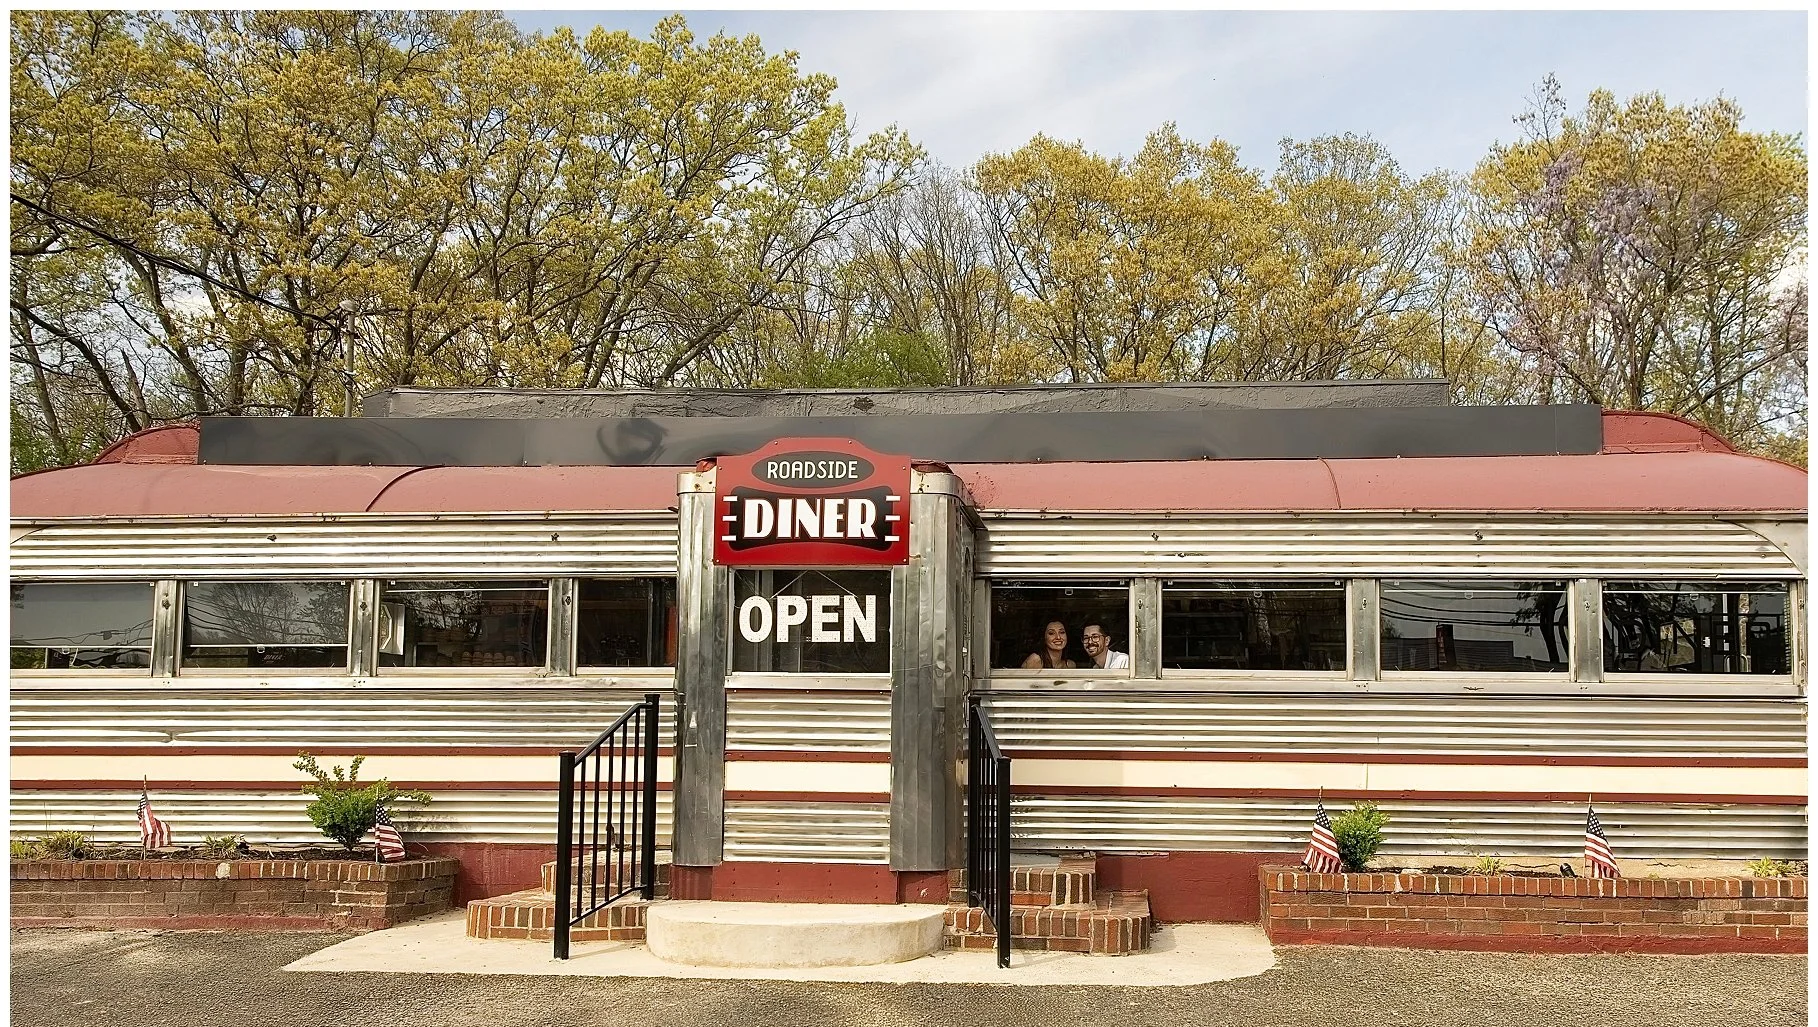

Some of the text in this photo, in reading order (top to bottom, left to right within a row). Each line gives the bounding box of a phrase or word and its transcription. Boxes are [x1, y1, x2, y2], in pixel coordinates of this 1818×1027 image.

[766, 460, 859, 479] ROADSIDE
[743, 497, 878, 540] DINER
[738, 594, 877, 643] OPEN
